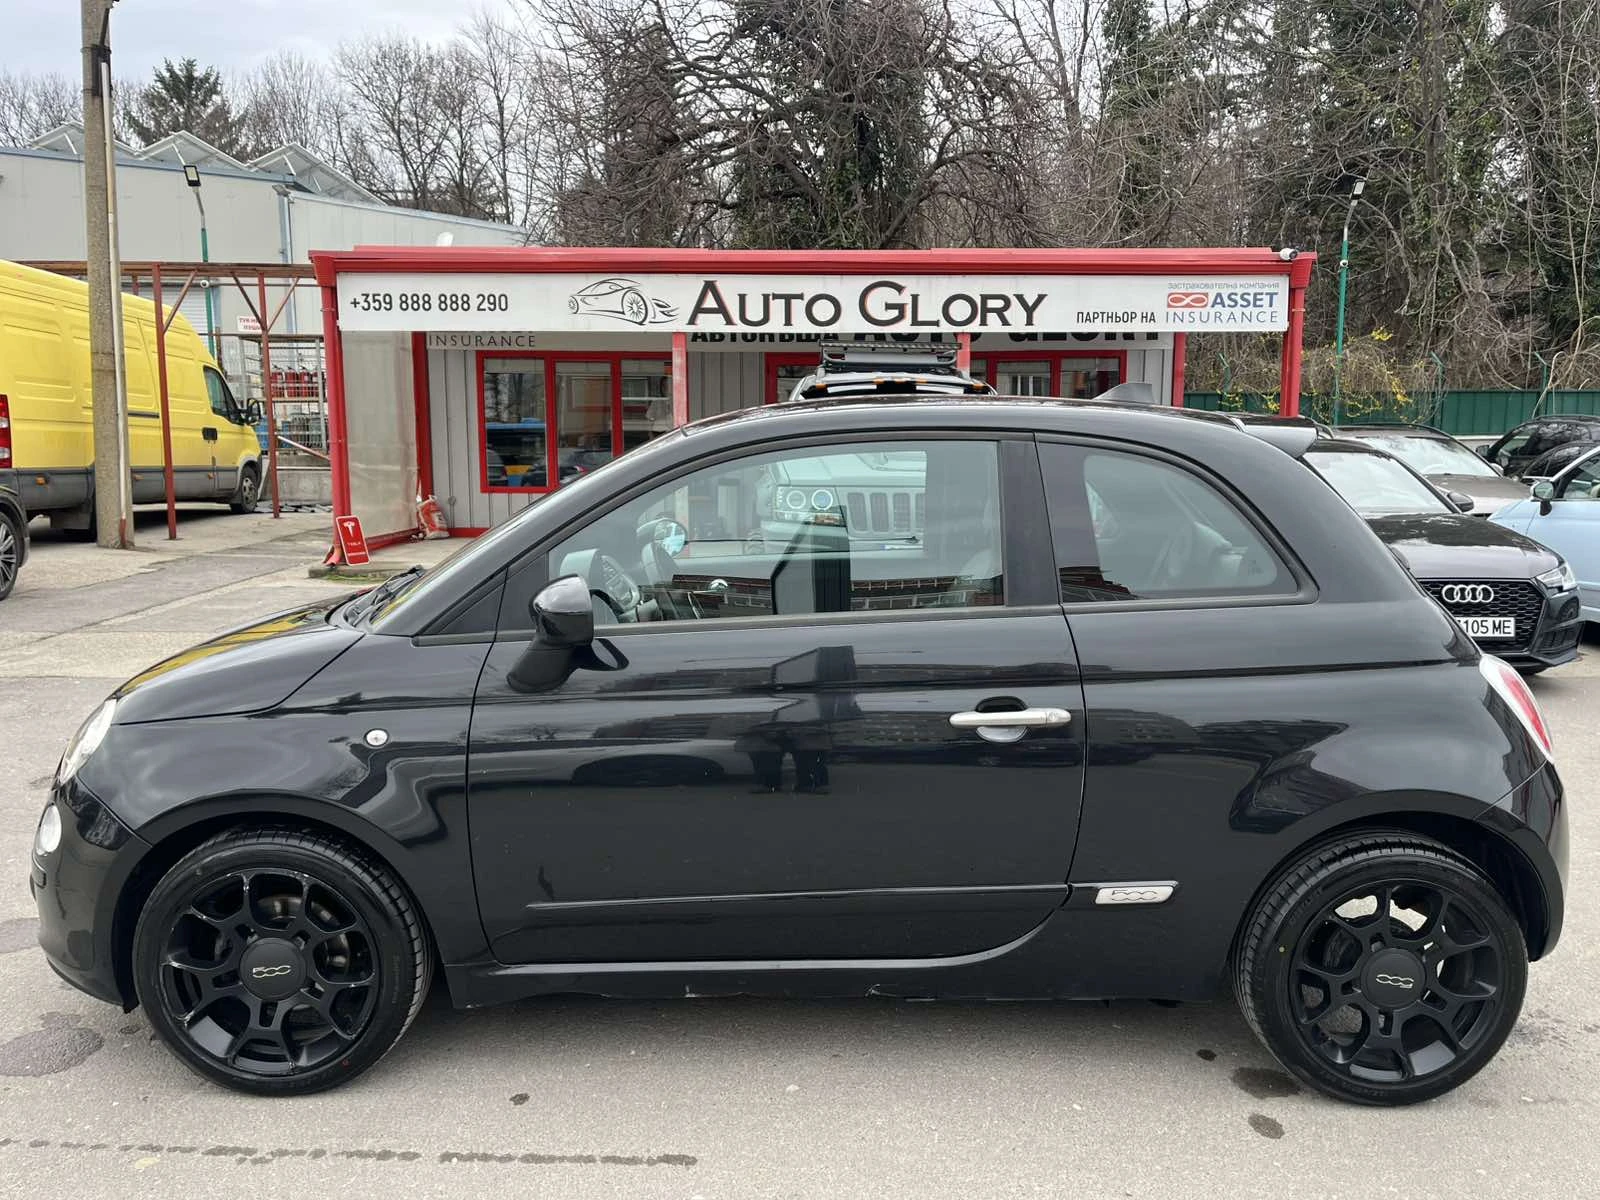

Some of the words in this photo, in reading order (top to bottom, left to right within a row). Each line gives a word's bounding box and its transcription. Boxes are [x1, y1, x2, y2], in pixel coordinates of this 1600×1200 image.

[350, 293, 393, 312] +359
[399, 293, 432, 312] 888
[438, 293, 471, 312] 888
[476, 293, 508, 312] 290
[1211, 292, 1279, 308] ASSET
[1076, 311, 1137, 324] ПАРТНЬОР
[1140, 311, 1156, 324] НА
[1165, 311, 1278, 323] INSURANCE
[428, 335, 536, 347] INSURANCE
[1457, 619, 1489, 634] 105
[1111, 889, 1158, 901] 500
[252, 965, 292, 978] 500
